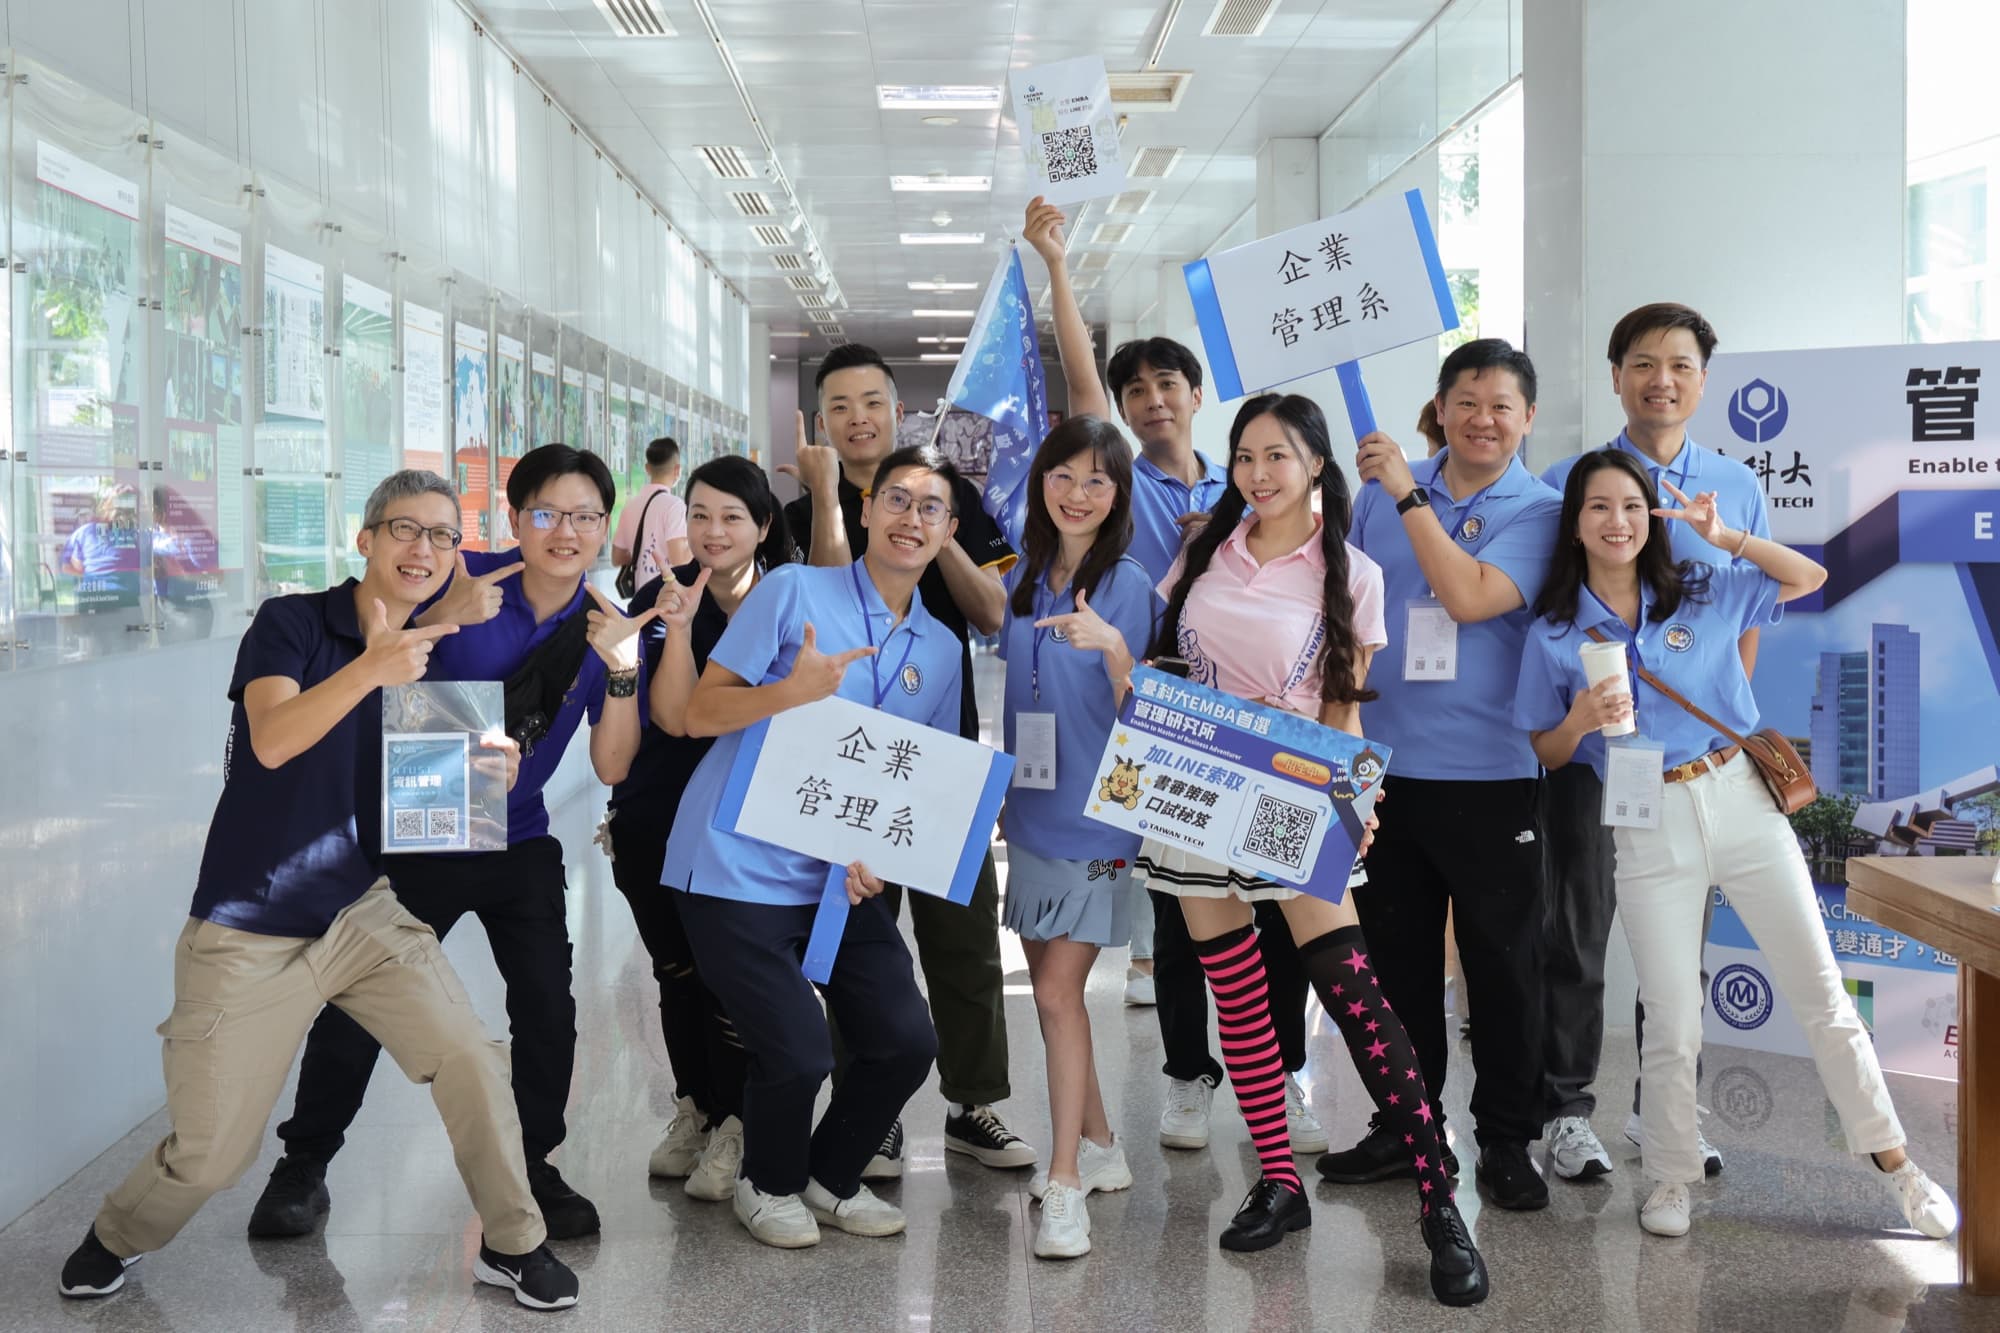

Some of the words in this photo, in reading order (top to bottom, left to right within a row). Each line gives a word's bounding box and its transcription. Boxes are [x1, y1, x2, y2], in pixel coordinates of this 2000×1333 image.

[1277, 233, 1352, 285] 企業
[1272, 282, 1389, 348] 管理系
[1906, 366, 1981, 442] 管
[1909, 457, 1988, 474] Enable
[1771, 497, 1814, 508] TECH
[1975, 512, 1993, 540] E
[1130, 717, 1151, 730] Enable
[1157, 726, 1177, 740] Master
[1184, 734, 1209, 750] Business
[1209, 744, 1243, 761] Adventurer
[1134, 699, 1218, 741] 管理研究所
[837, 726, 921, 781] 企業
[1144, 744, 1246, 792] 加LINE索取
[796, 775, 914, 847] 管理系
[1153, 774, 1220, 808] 書審策略
[1149, 823, 1181, 839] TAIWAN
[1183, 835, 1205, 847] TECH
